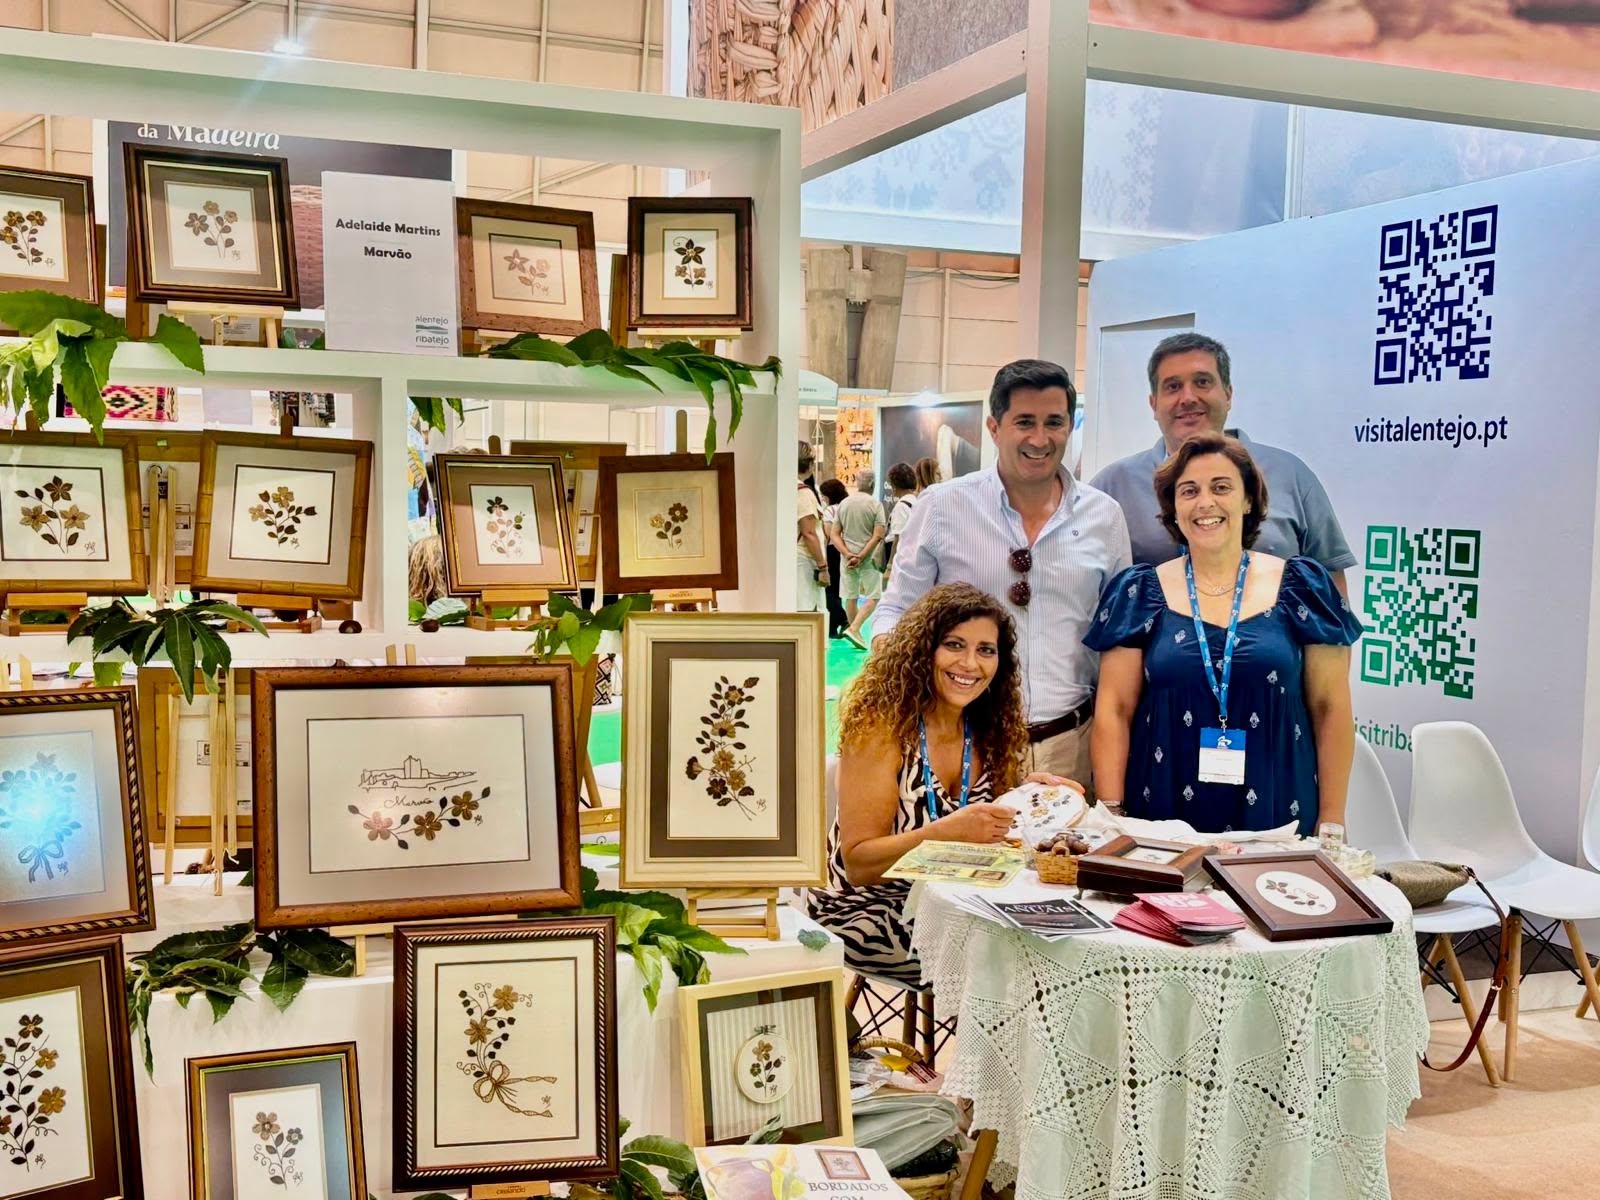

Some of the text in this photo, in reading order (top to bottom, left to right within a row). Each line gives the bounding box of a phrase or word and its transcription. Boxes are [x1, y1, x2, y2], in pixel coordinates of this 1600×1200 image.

[137, 123, 280, 151] da Madeira
[335, 218, 441, 237] Adelaide Martins
[363, 245, 412, 260] Marvão
[415, 315, 449, 326] alentejo
[415, 335, 449, 346] ribatejo
[1354, 413, 1508, 449] visitalentejo.pt
[808, 1181, 889, 1192] BORDADOS
